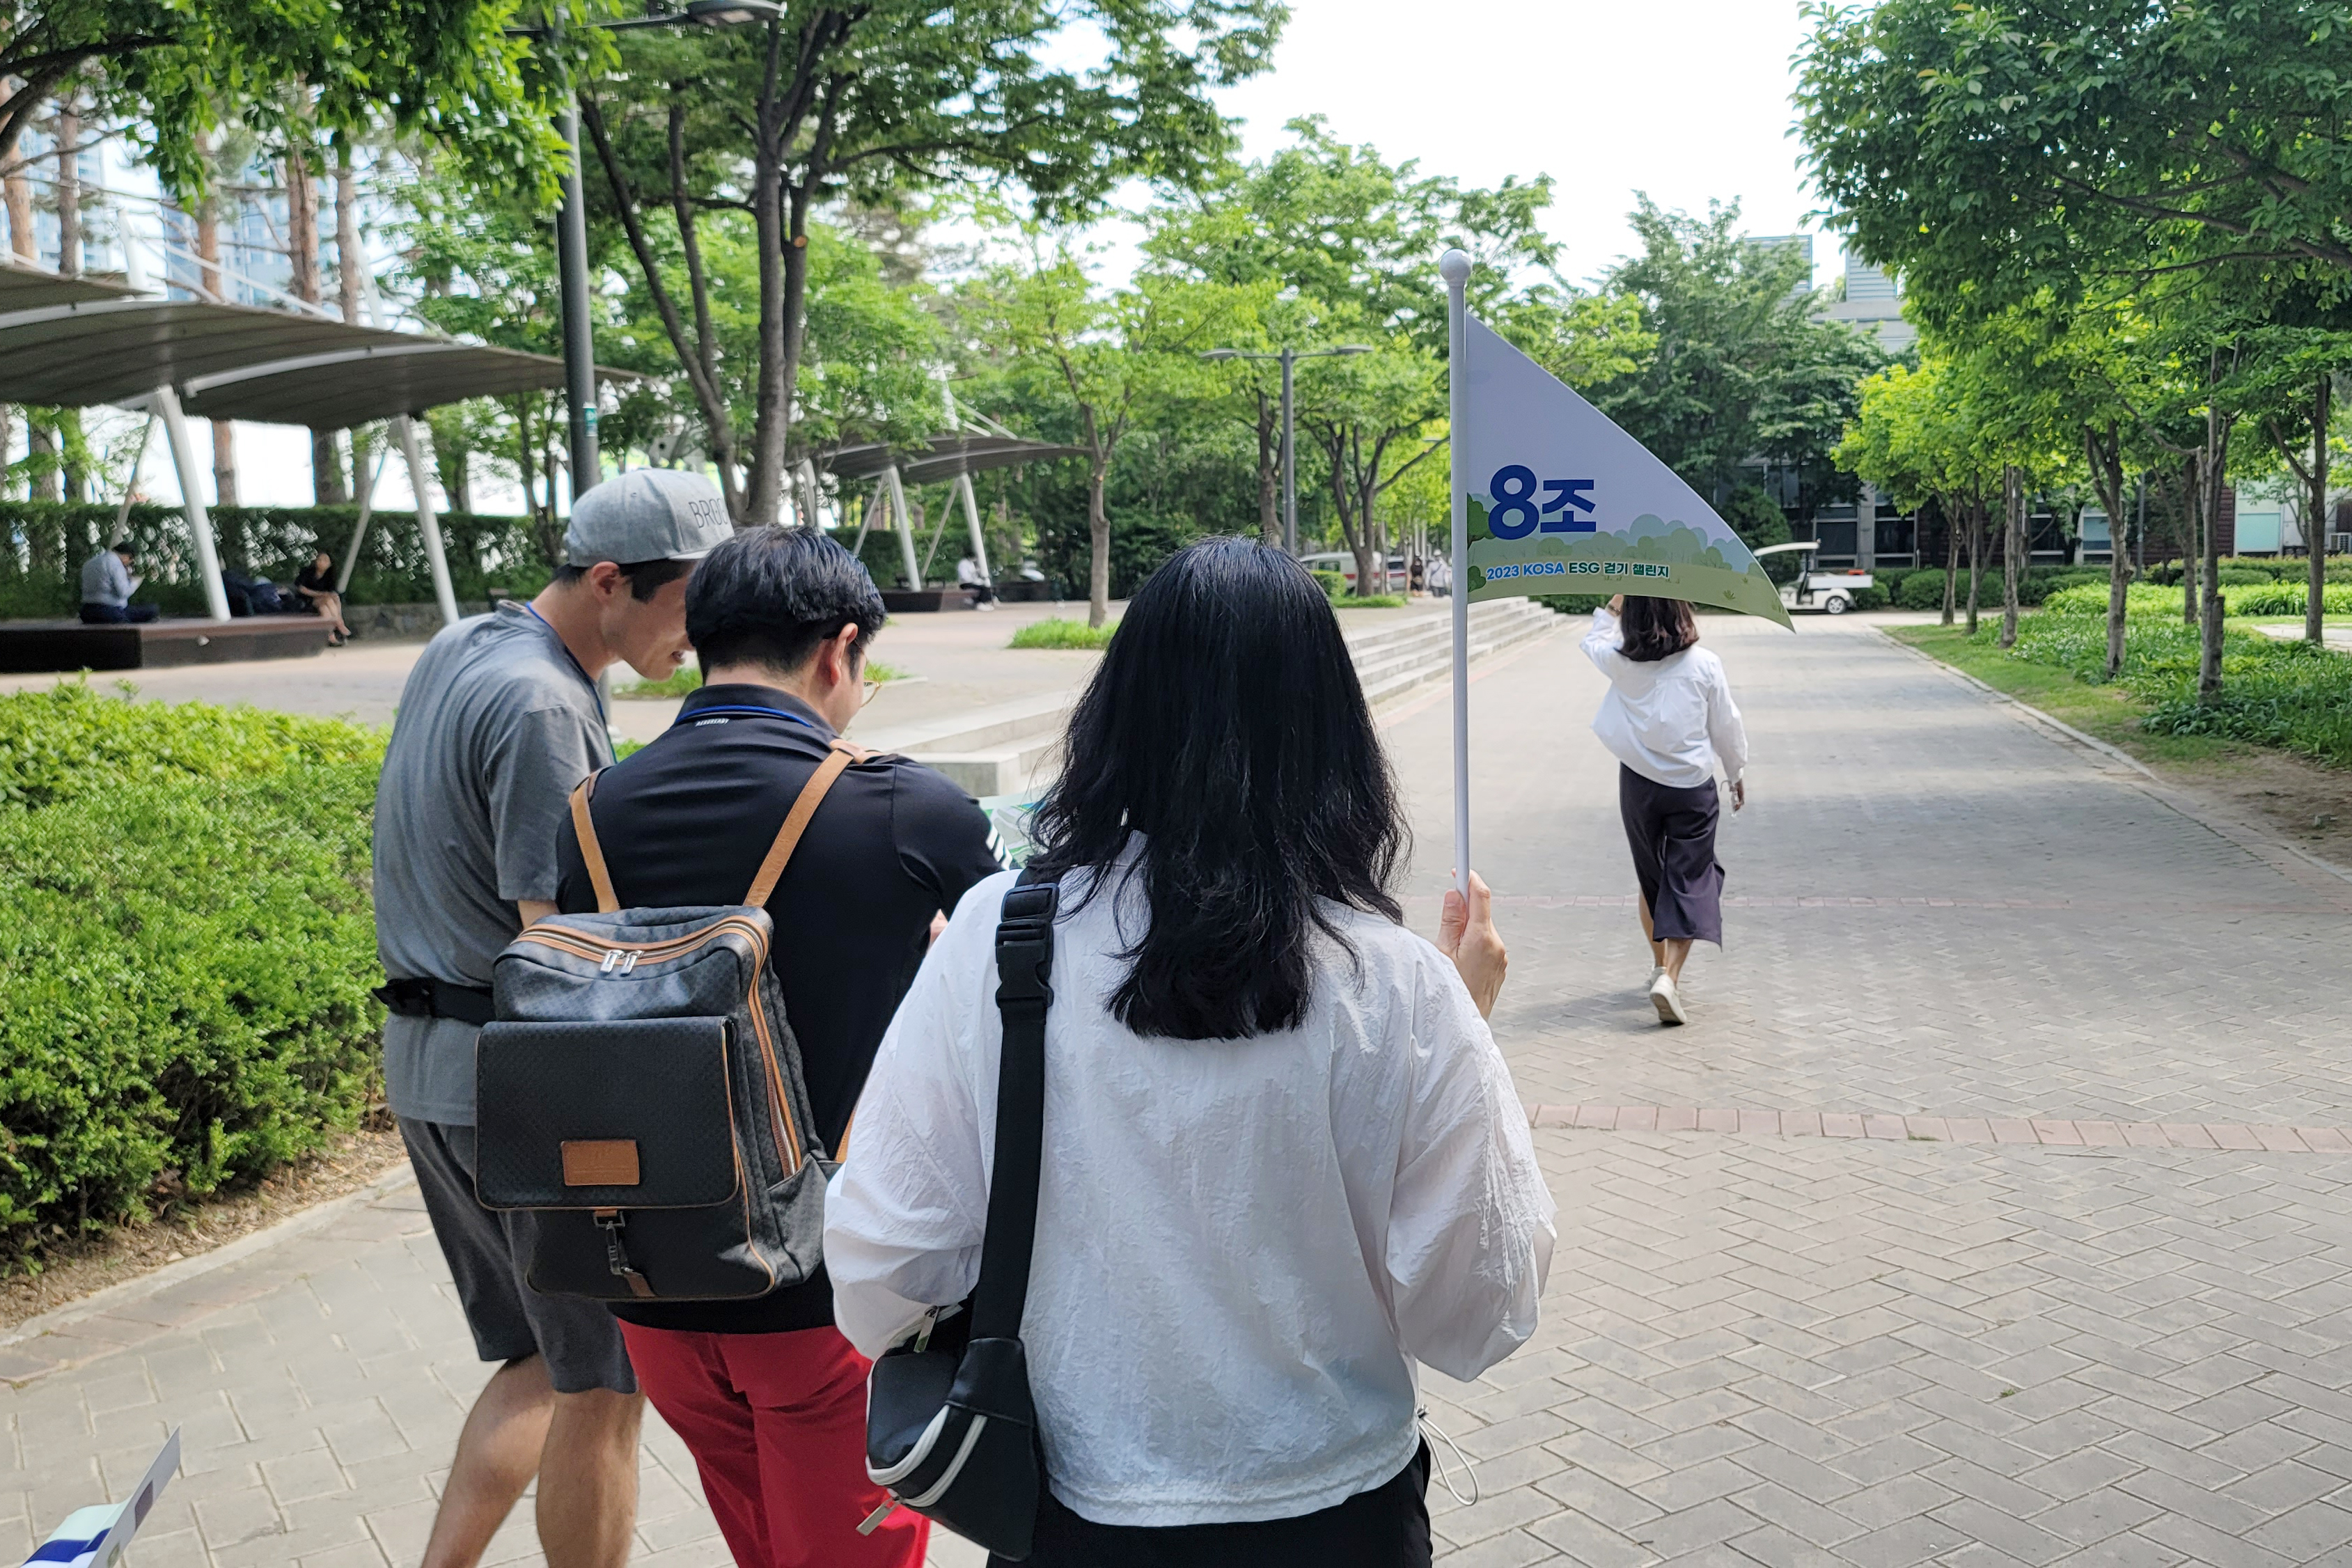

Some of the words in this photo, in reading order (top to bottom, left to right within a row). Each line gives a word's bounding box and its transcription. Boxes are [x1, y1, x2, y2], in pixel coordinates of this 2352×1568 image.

[1488, 464, 1597, 540] 8조
[1486, 565, 1520, 580] 2023
[1523, 562, 1565, 576] KOSA
[1569, 562, 1600, 574] ESG
[1604, 562, 1629, 575] 걷기
[1632, 563, 1670, 578] 챌린지
